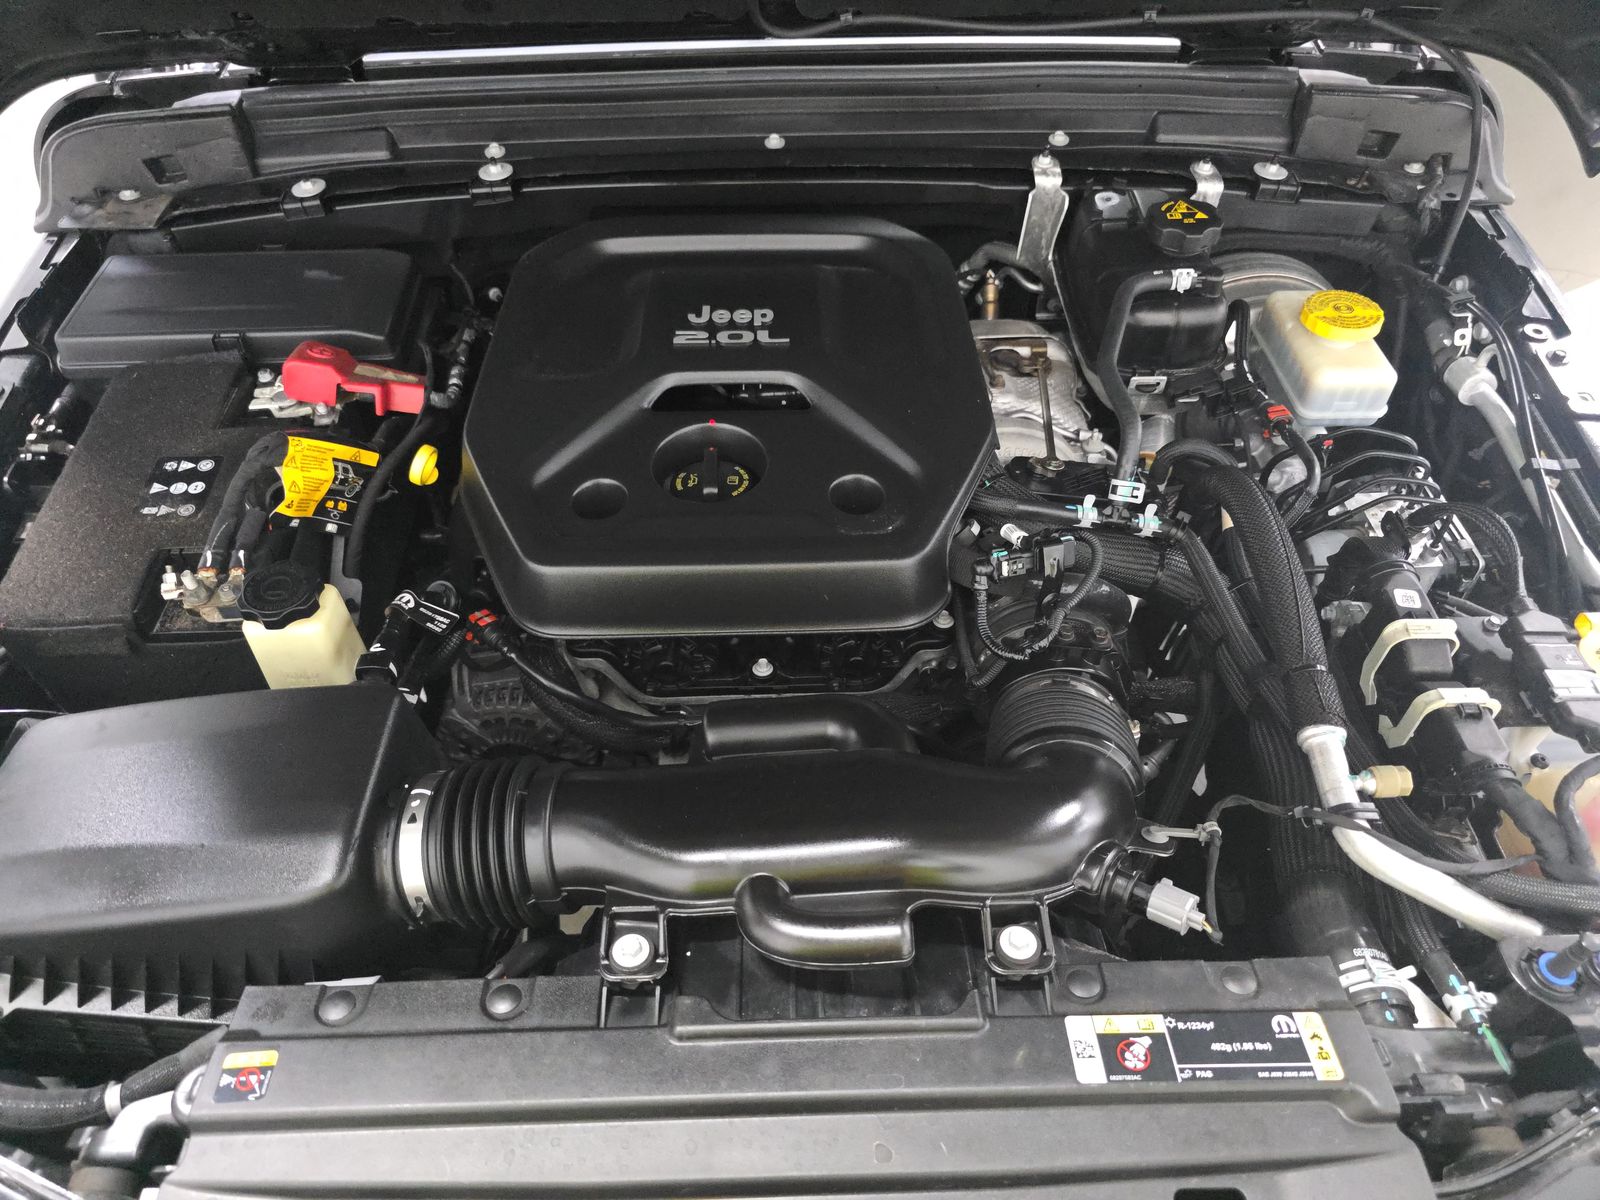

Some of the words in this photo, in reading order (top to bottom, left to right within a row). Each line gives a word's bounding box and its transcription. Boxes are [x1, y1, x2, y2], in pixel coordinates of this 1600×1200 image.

[687, 305, 775, 326] Jeep
[672, 330, 791, 345] 2.0L
[1177, 1021, 1215, 1031] R-1234yf
[1195, 1070, 1214, 1078] PAG
